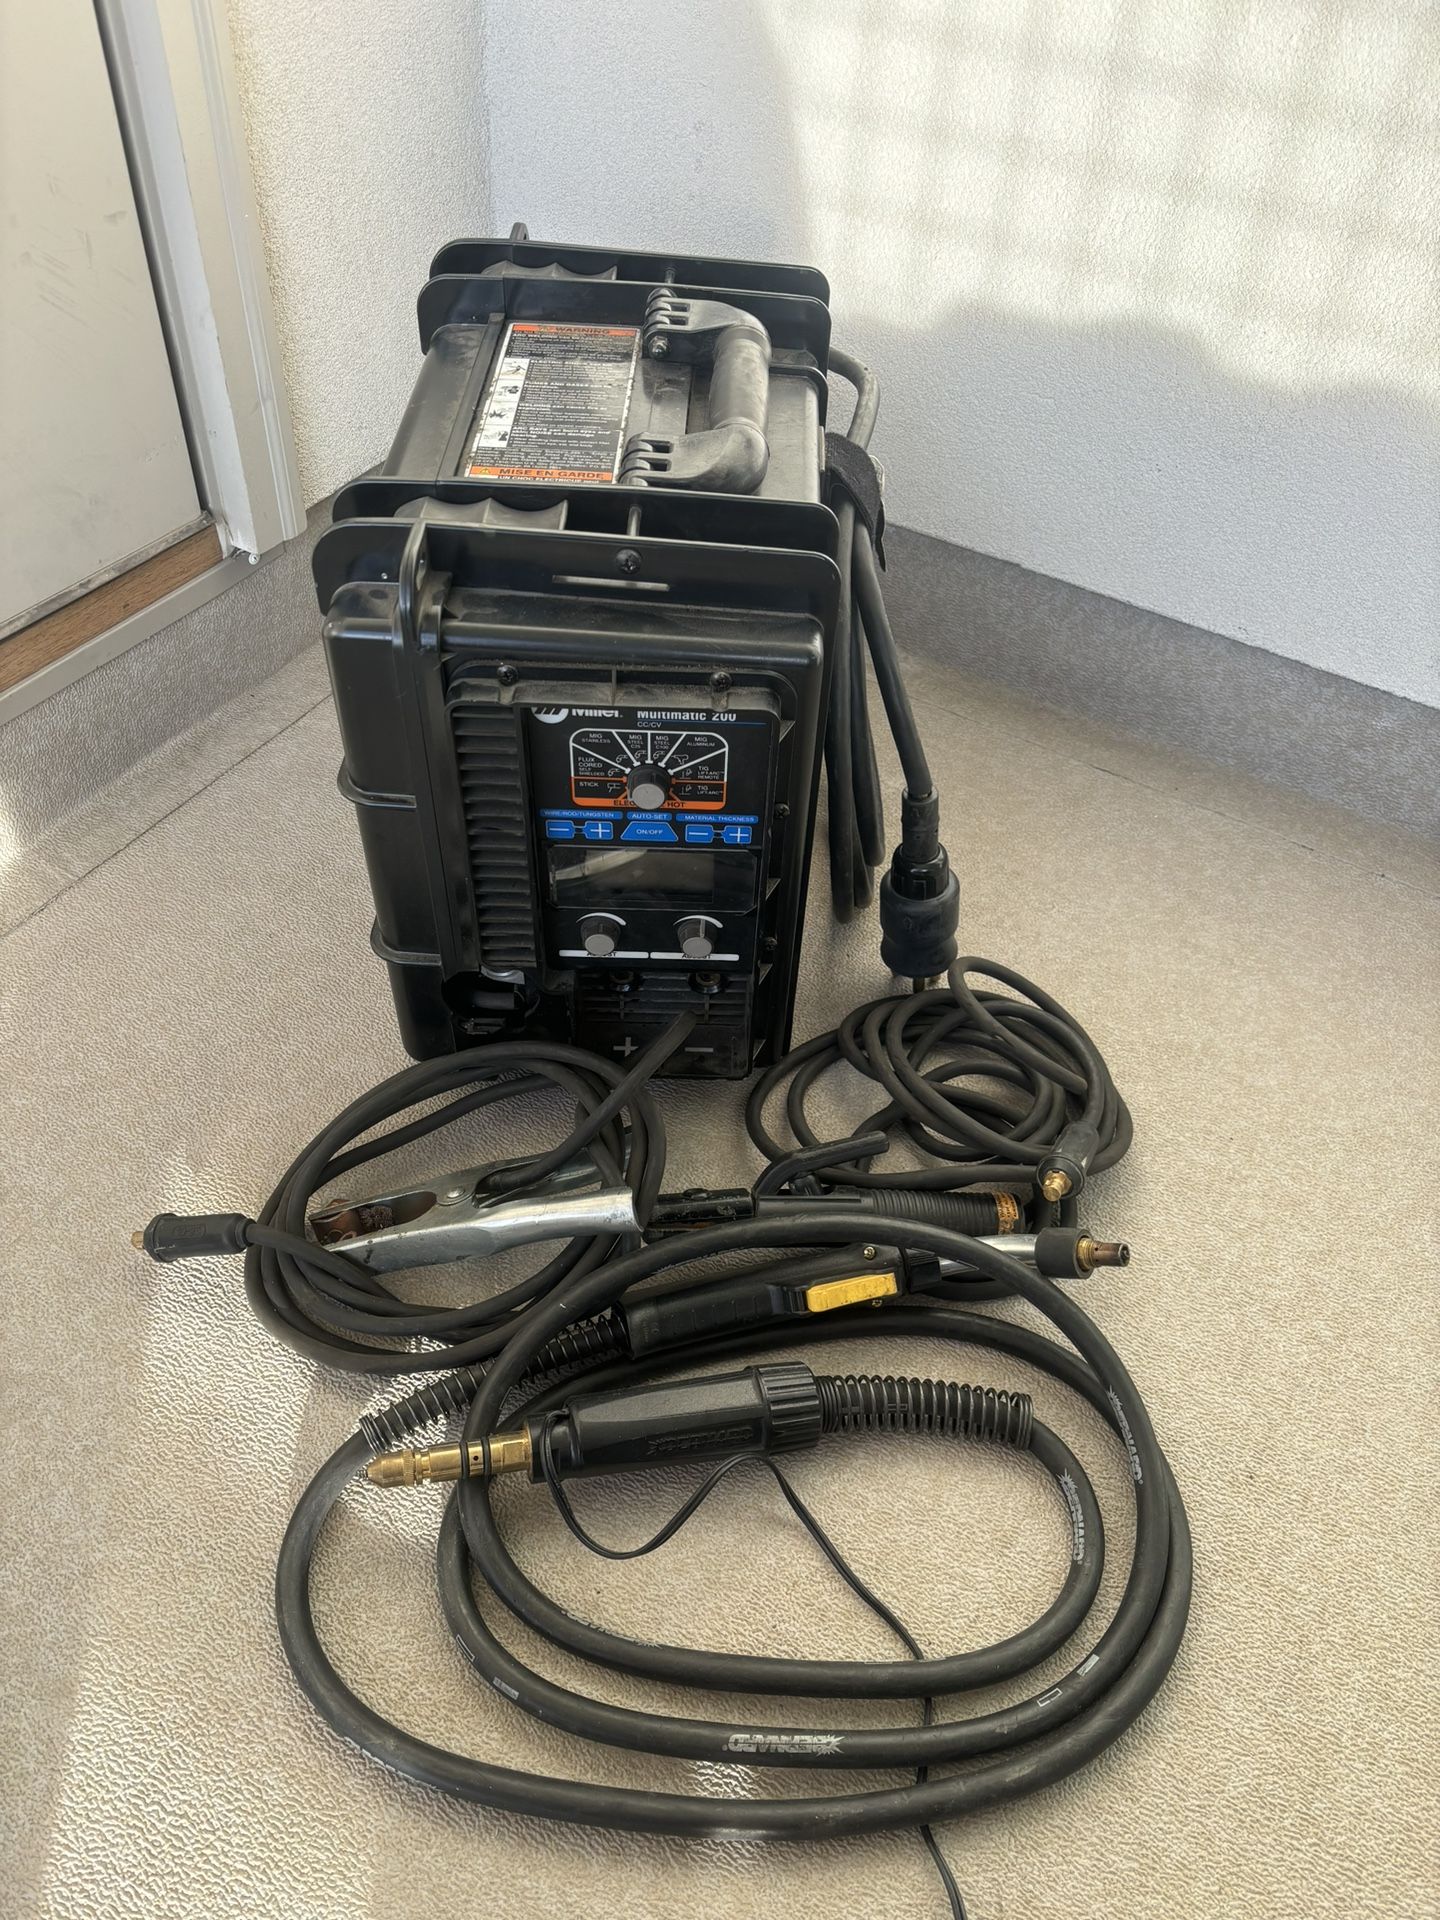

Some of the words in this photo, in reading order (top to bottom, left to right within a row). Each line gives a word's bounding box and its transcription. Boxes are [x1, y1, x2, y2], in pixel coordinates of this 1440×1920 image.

[500, 468, 532, 476] MISE
[558, 470, 604, 479] GARDE
[637, 710, 707, 721] Multimatic
[711, 712, 737, 722] 200
